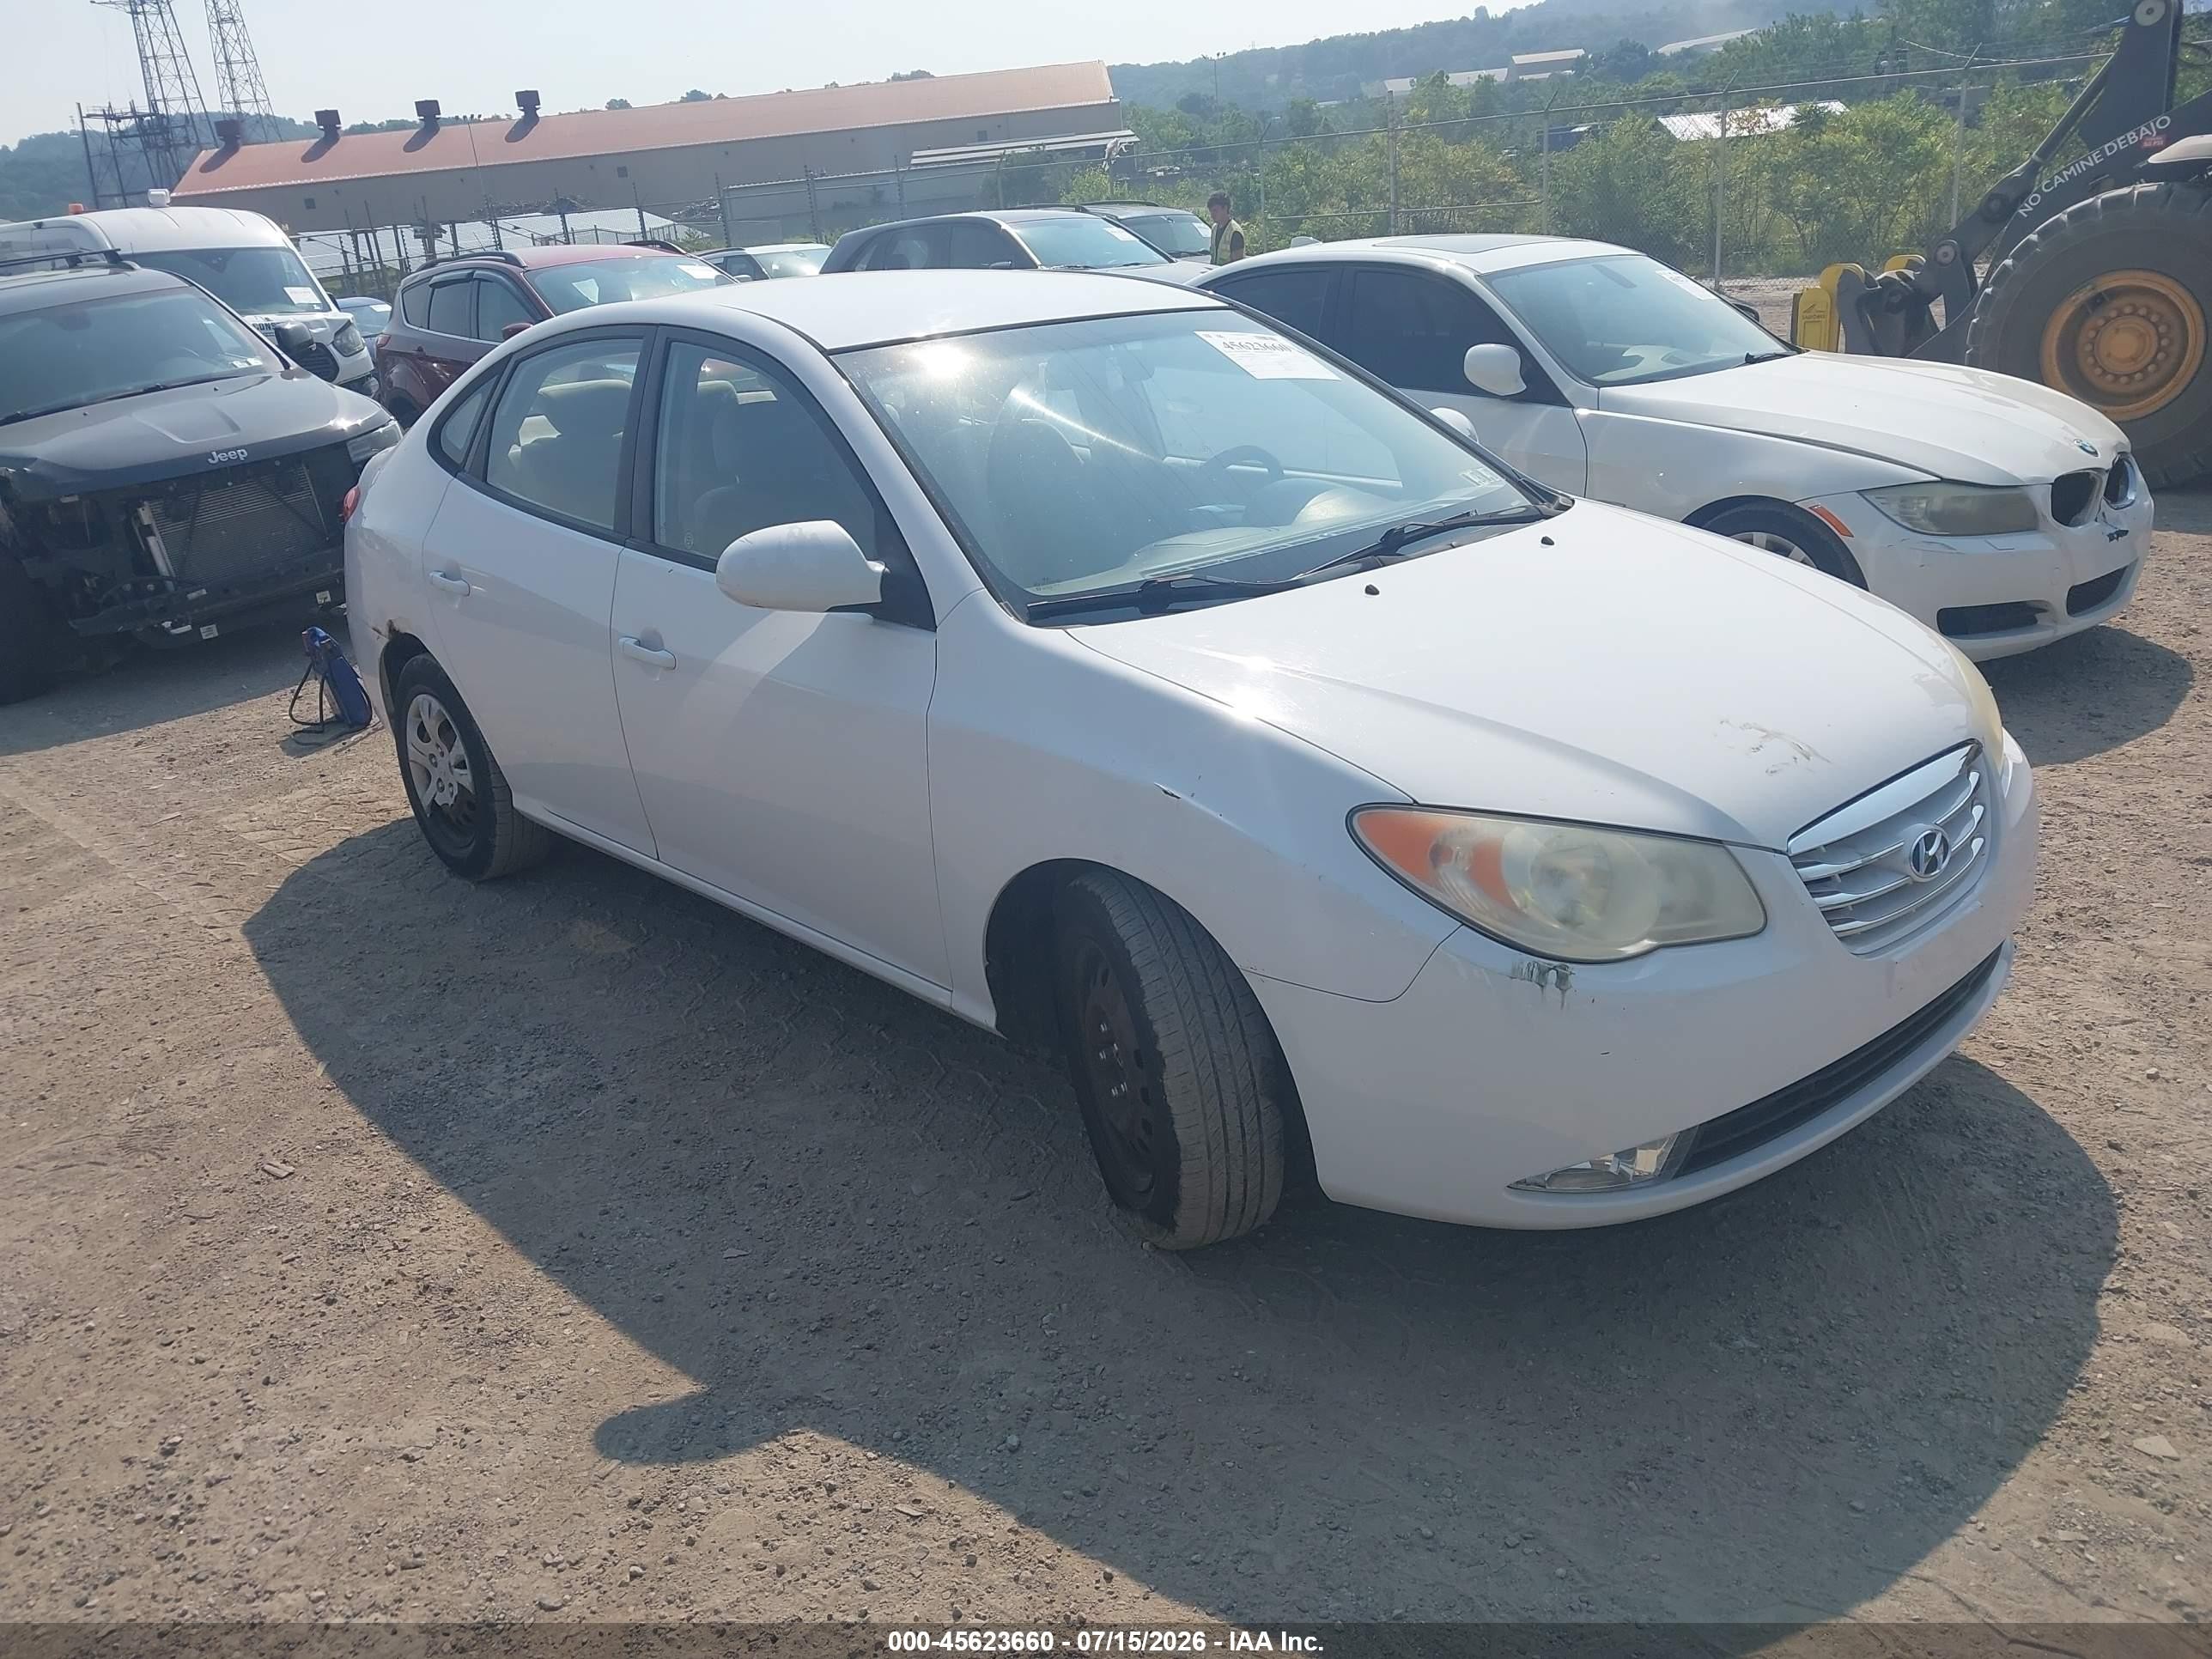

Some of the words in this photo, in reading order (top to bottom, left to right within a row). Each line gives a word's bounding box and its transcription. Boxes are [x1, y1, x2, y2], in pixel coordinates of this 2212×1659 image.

[2018, 193, 2041, 217] NO
[2042, 150, 2104, 192] CAMINE
[2105, 115, 2171, 156] DEBAJO
[208, 449, 248, 464] Jeep
